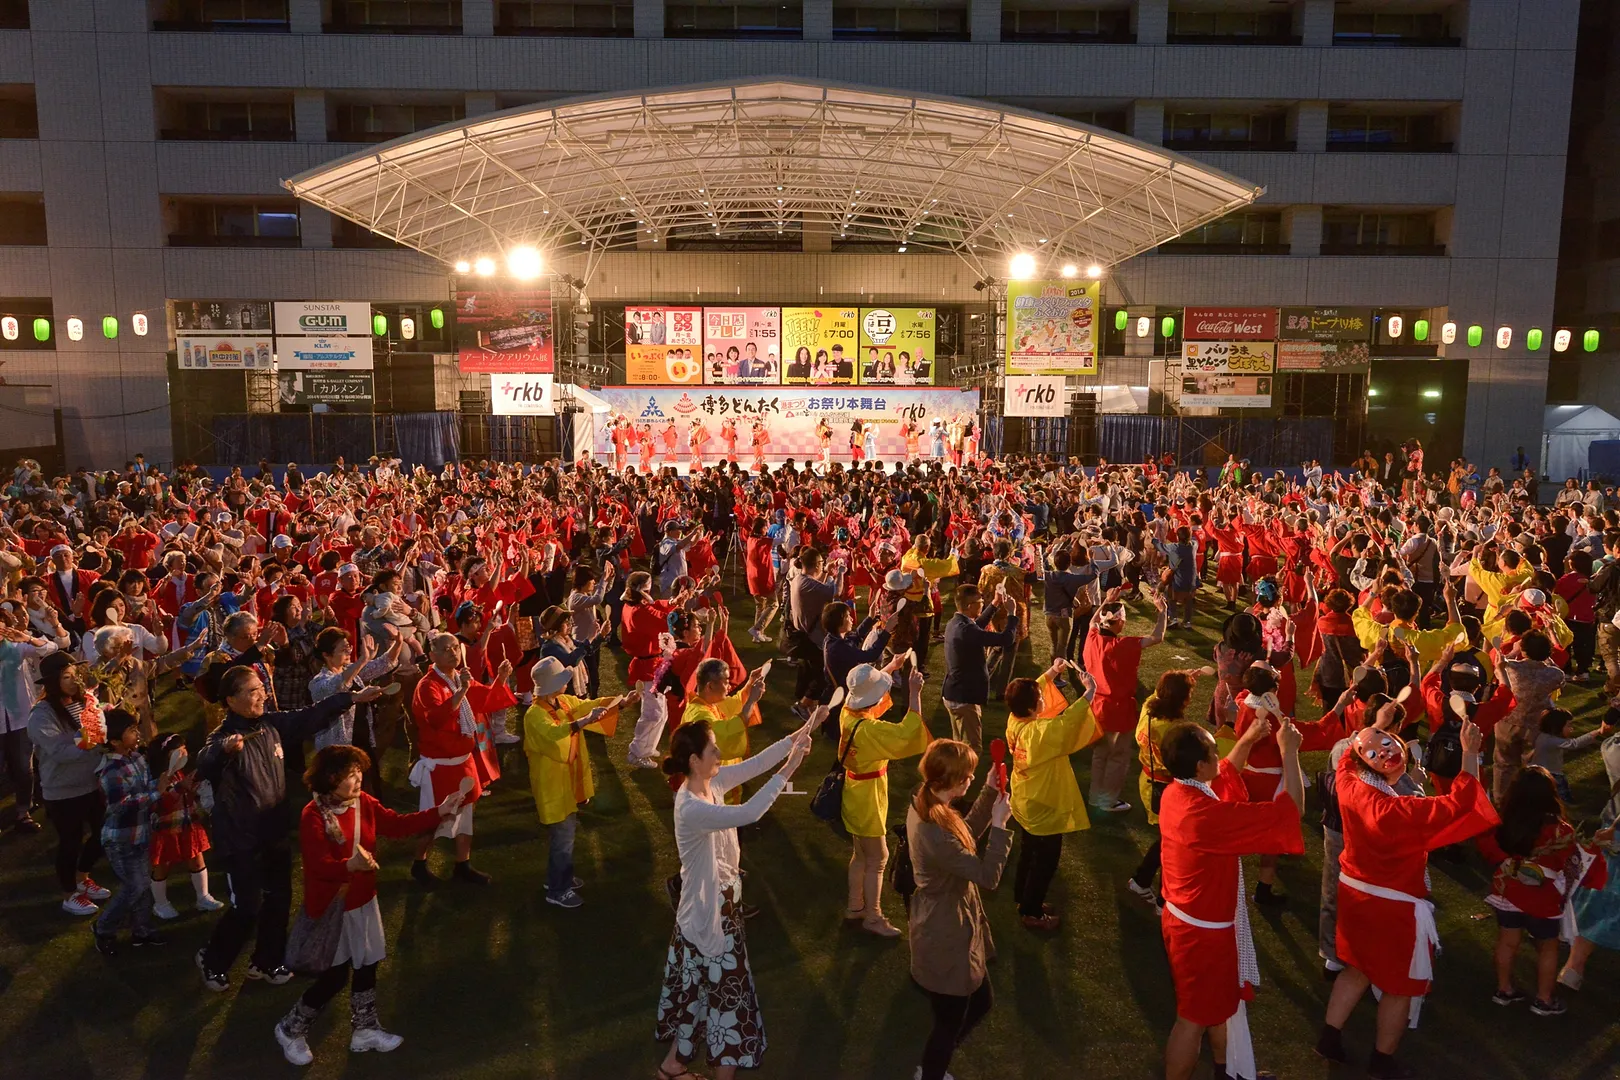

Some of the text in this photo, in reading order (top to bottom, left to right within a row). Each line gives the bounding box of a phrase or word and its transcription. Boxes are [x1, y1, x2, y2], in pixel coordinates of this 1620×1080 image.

[786, 318, 820, 333] TEEN!
[1234, 319, 1263, 334] West
[754, 329, 777, 338] 1:55
[786, 332, 820, 347] TEEN!
[829, 330, 854, 338] 7:00
[1205, 344, 1250, 355] バリうま
[464, 353, 548, 362] アートアクアリウム展
[700, 394, 780, 415] 博多どんたく
[808, 397, 887, 410] お祭り本舞台
